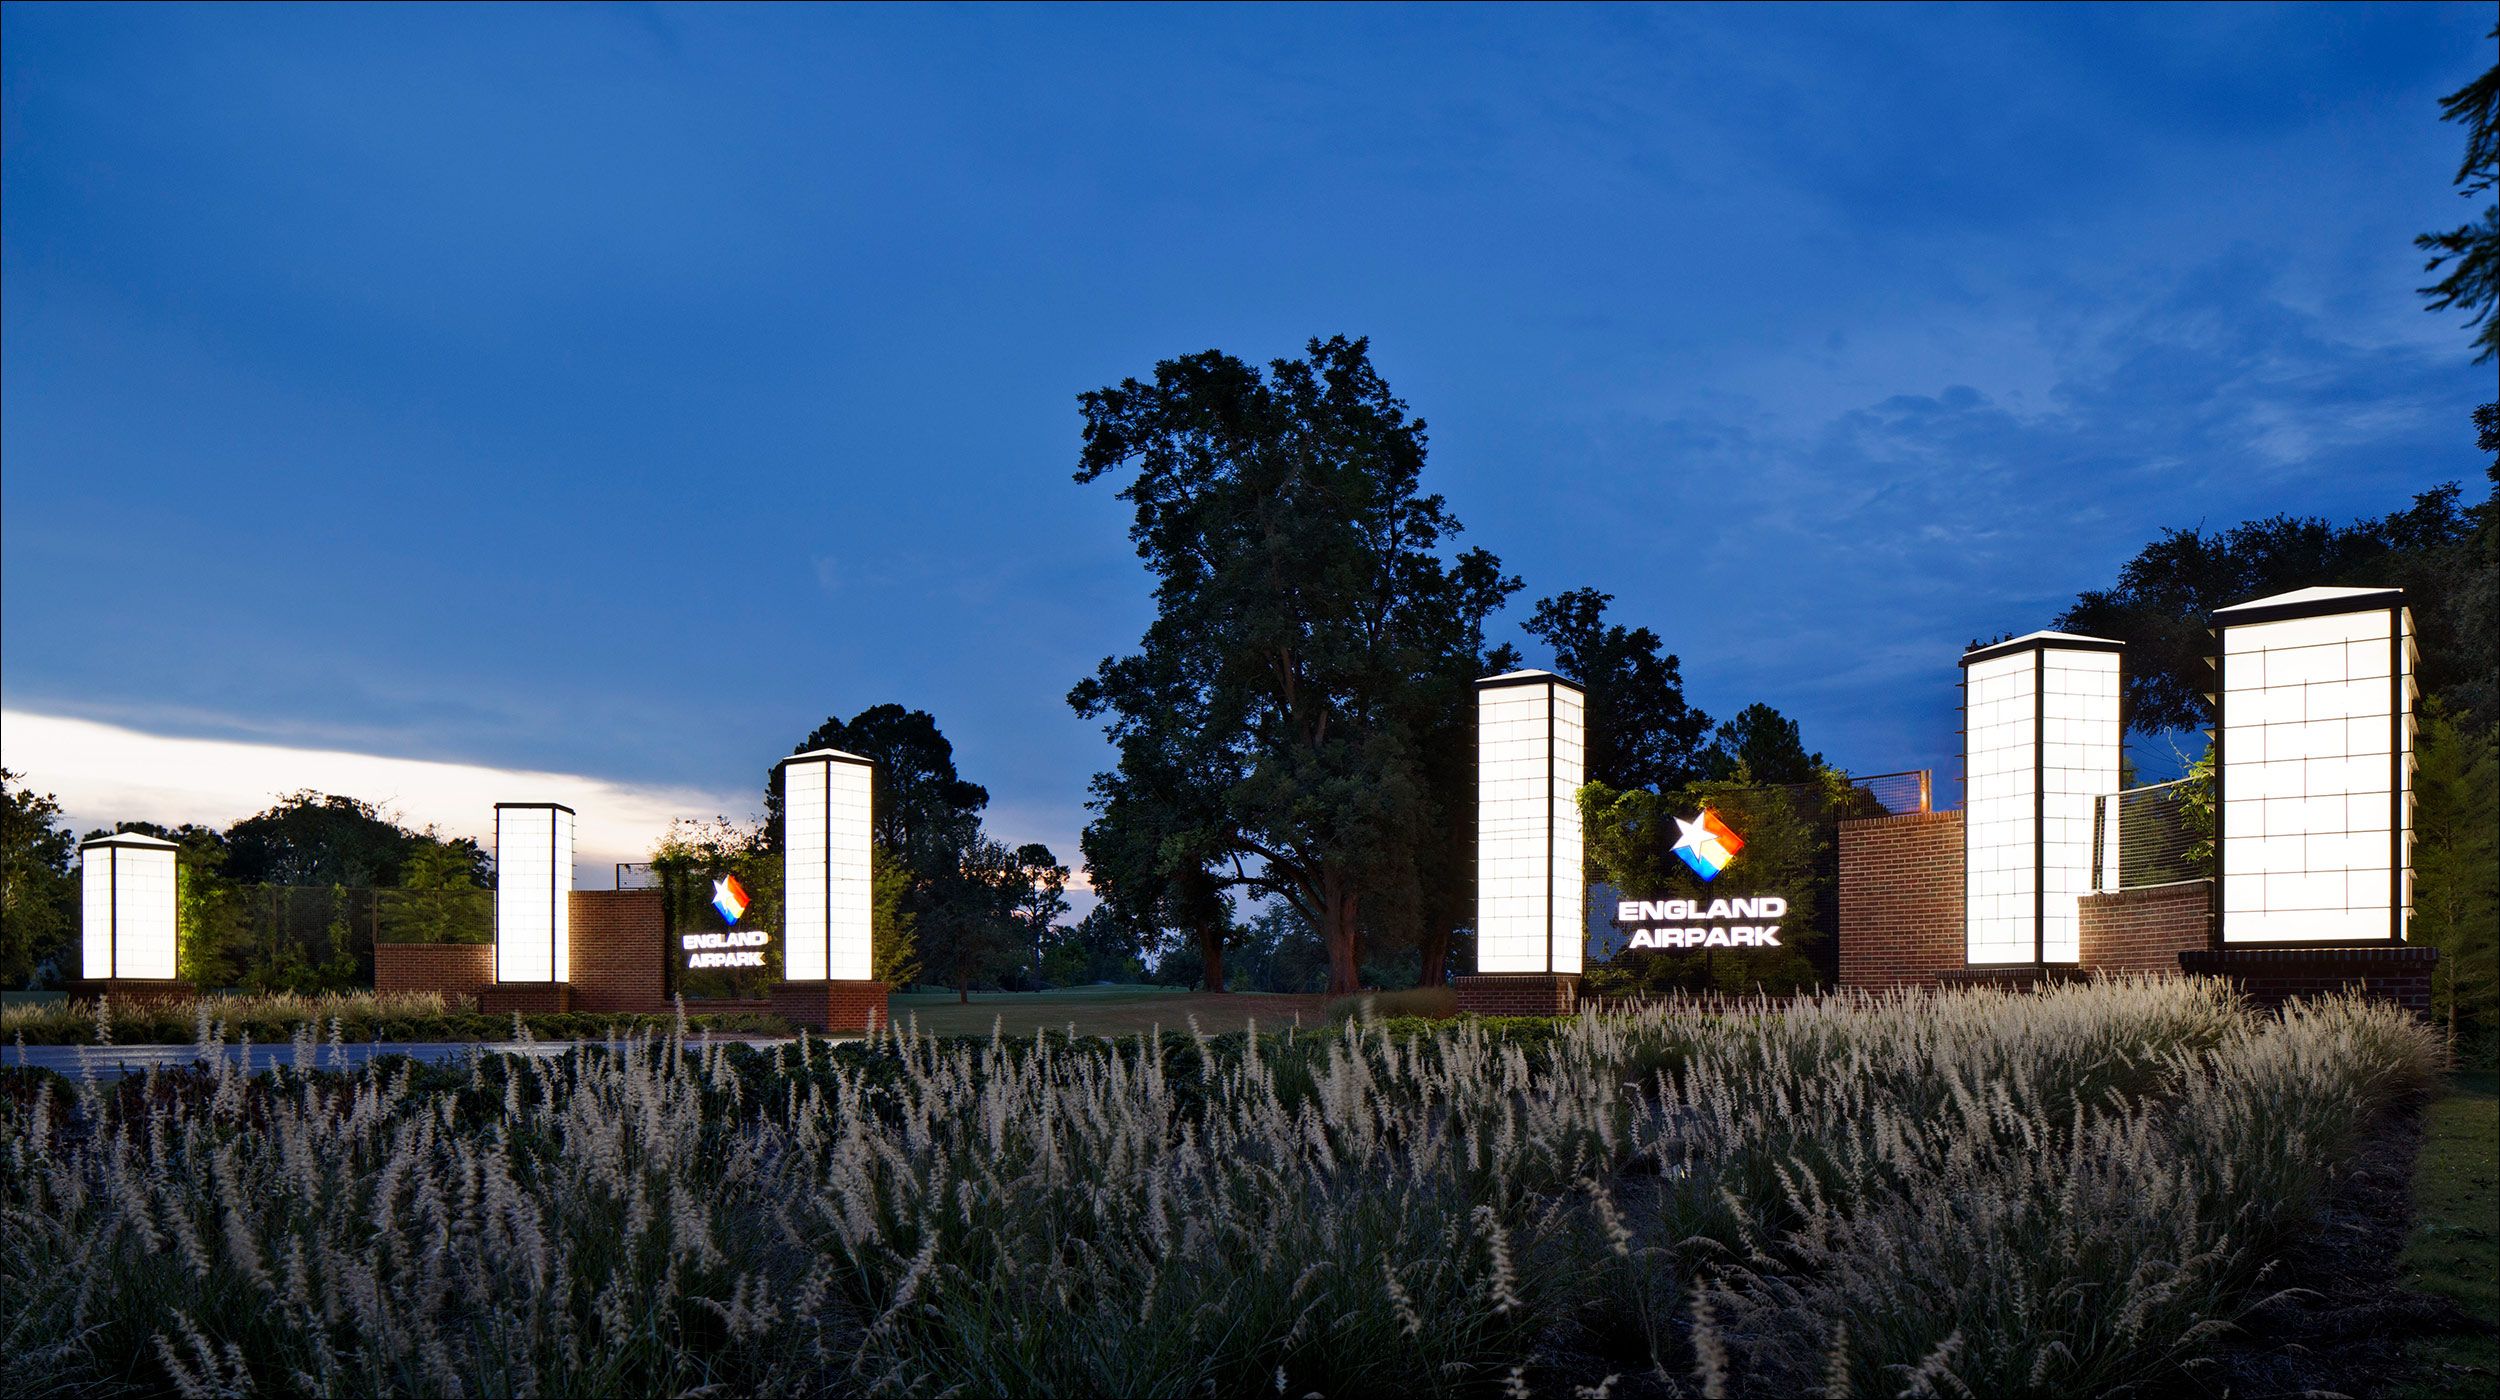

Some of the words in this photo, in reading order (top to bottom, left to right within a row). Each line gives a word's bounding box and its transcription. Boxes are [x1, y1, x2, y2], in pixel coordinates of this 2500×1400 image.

[1618, 897, 1787, 921] ENGLAND
[682, 931, 769, 949] ENGLAND
[1628, 926, 1783, 949] AIRPARK
[688, 951, 766, 968] AIRPARK
